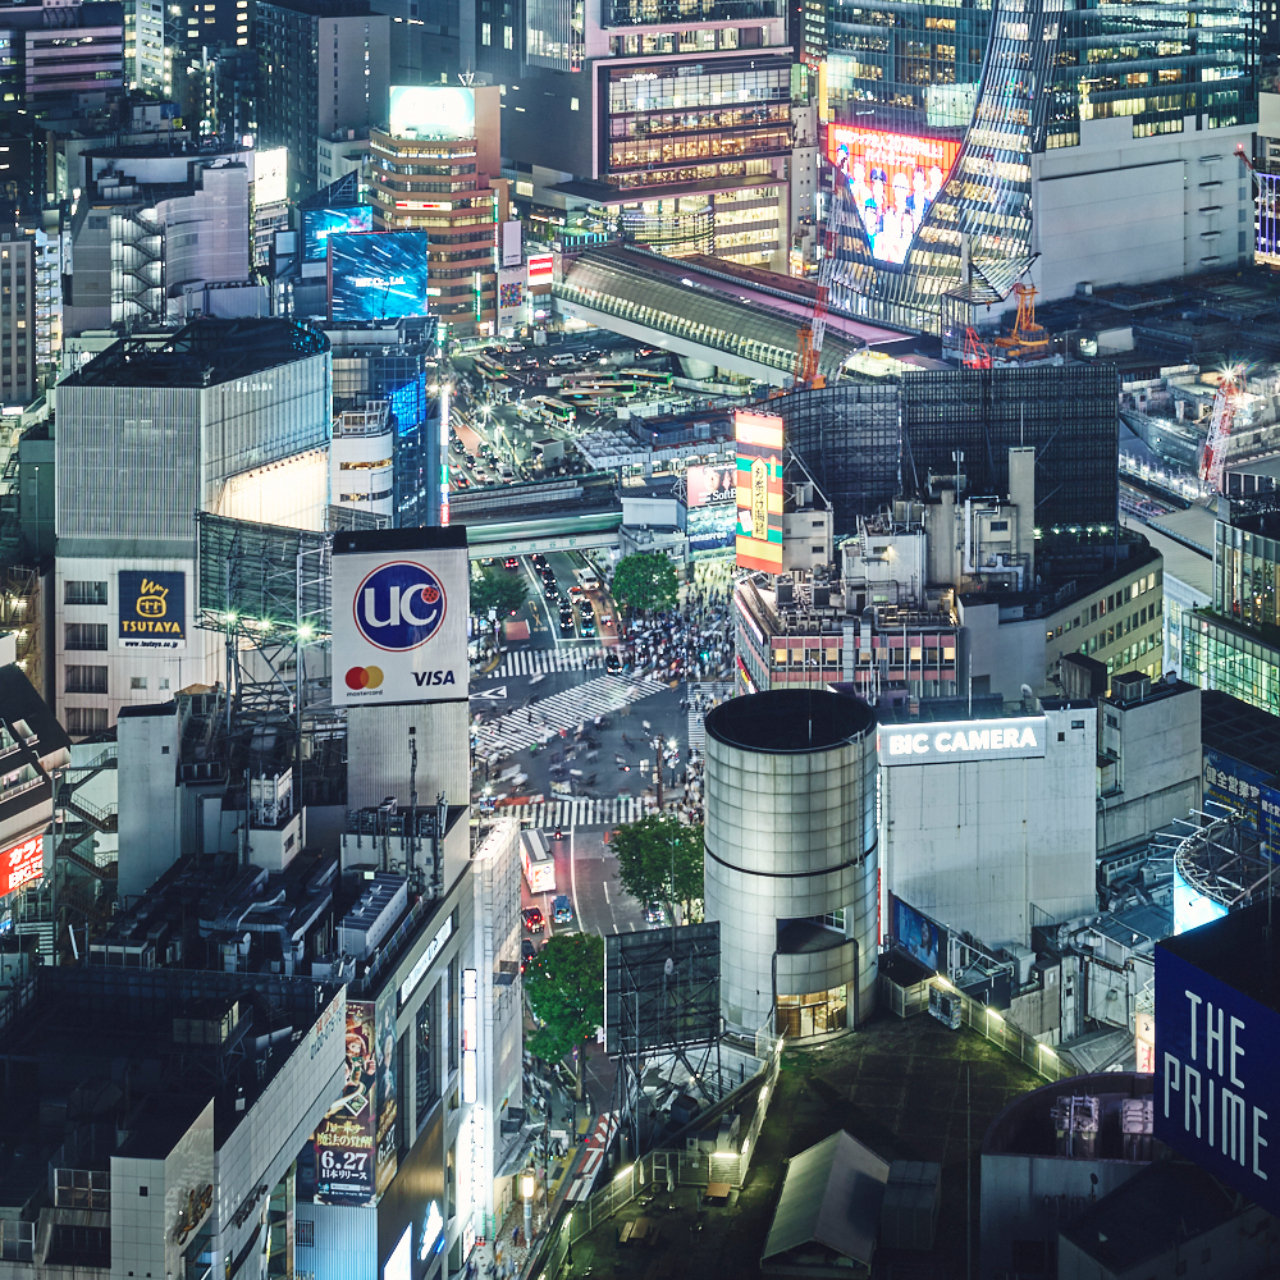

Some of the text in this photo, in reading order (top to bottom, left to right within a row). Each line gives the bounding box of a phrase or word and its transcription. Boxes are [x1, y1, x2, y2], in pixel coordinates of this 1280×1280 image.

[122, 620, 181, 633] TSUTAYA
[410, 670, 456, 687] VISA
[346, 689, 384, 698] mastercard
[888, 727, 1038, 755] BIC CAMERA
[1184, 989, 1246, 1089] THE
[1163, 1051, 1269, 1181] PRIME
[321, 1150, 368, 1171] 6.27
[322, 1169, 368, 1181] 日本リリース
